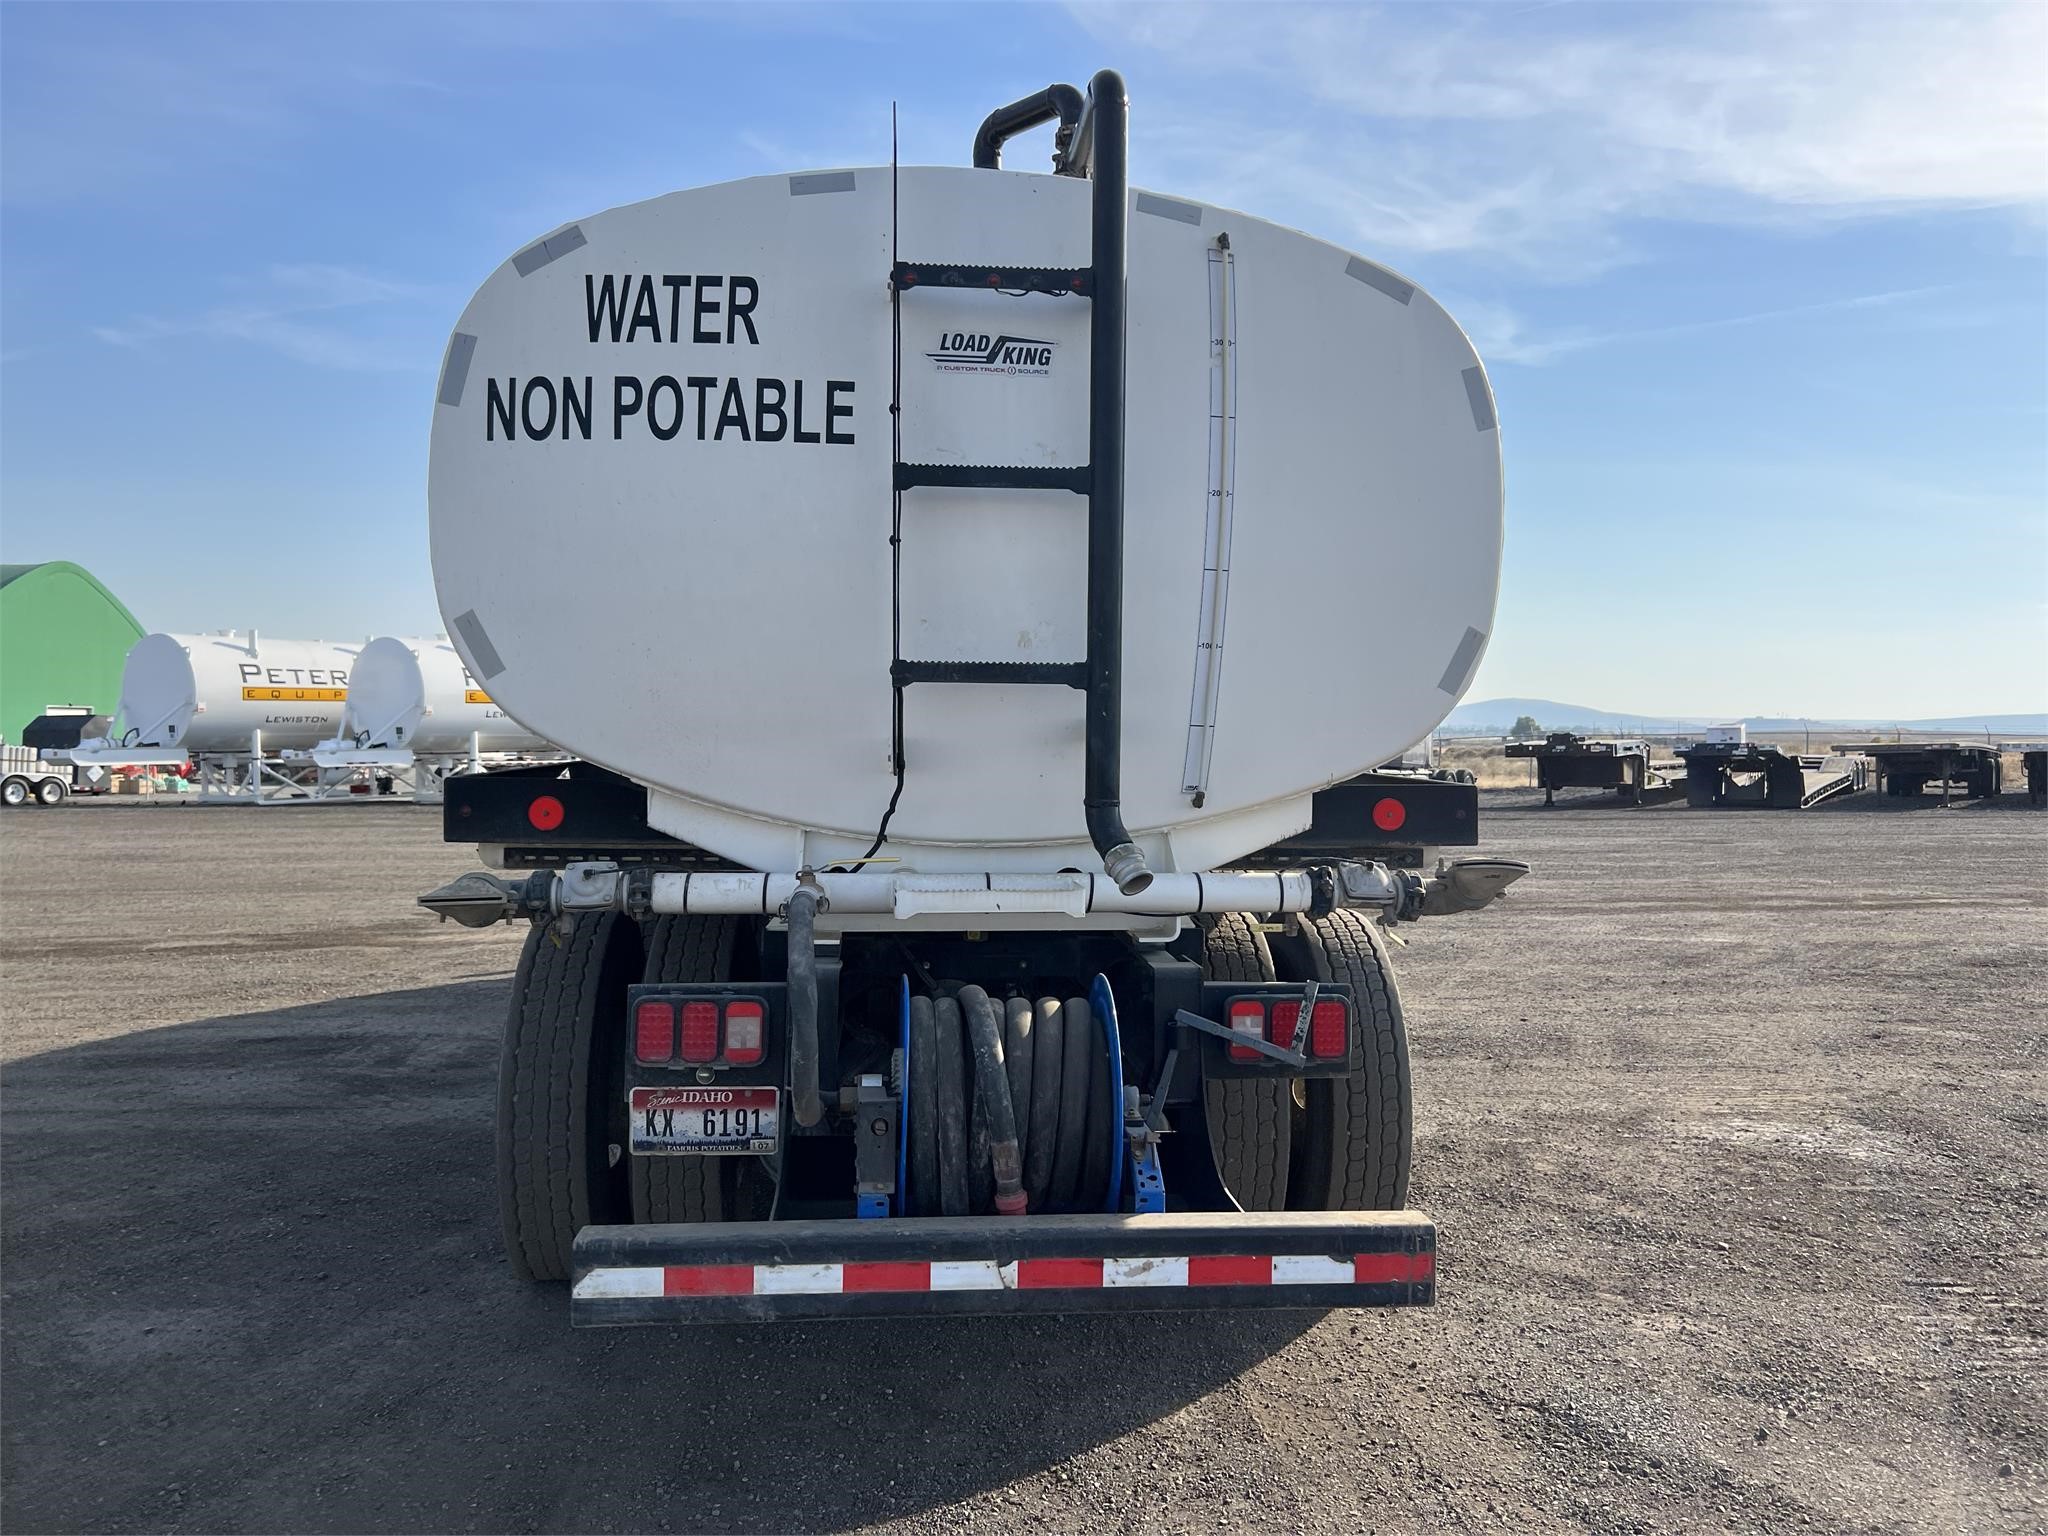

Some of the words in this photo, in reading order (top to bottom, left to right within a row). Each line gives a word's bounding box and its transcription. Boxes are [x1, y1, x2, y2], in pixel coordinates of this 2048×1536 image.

[586, 275, 759, 345] WATER
[940, 333, 990, 352] LOAD
[1002, 346, 1052, 367] KING
[486, 375, 593, 442] NON
[613, 375, 856, 445] POTABLE
[238, 663, 348, 685] PETER
[247, 690, 342, 699] EQUIP
[265, 715, 329, 724] LEWISTON
[647, 1094, 682, 1107] Scenic
[681, 1091, 733, 1103] IDAHO
[645, 1108, 674, 1137] KX
[703, 1108, 763, 1137] 6191
[667, 1144, 699, 1152] FAMOUS
[701, 1144, 742, 1152] POTATOES
